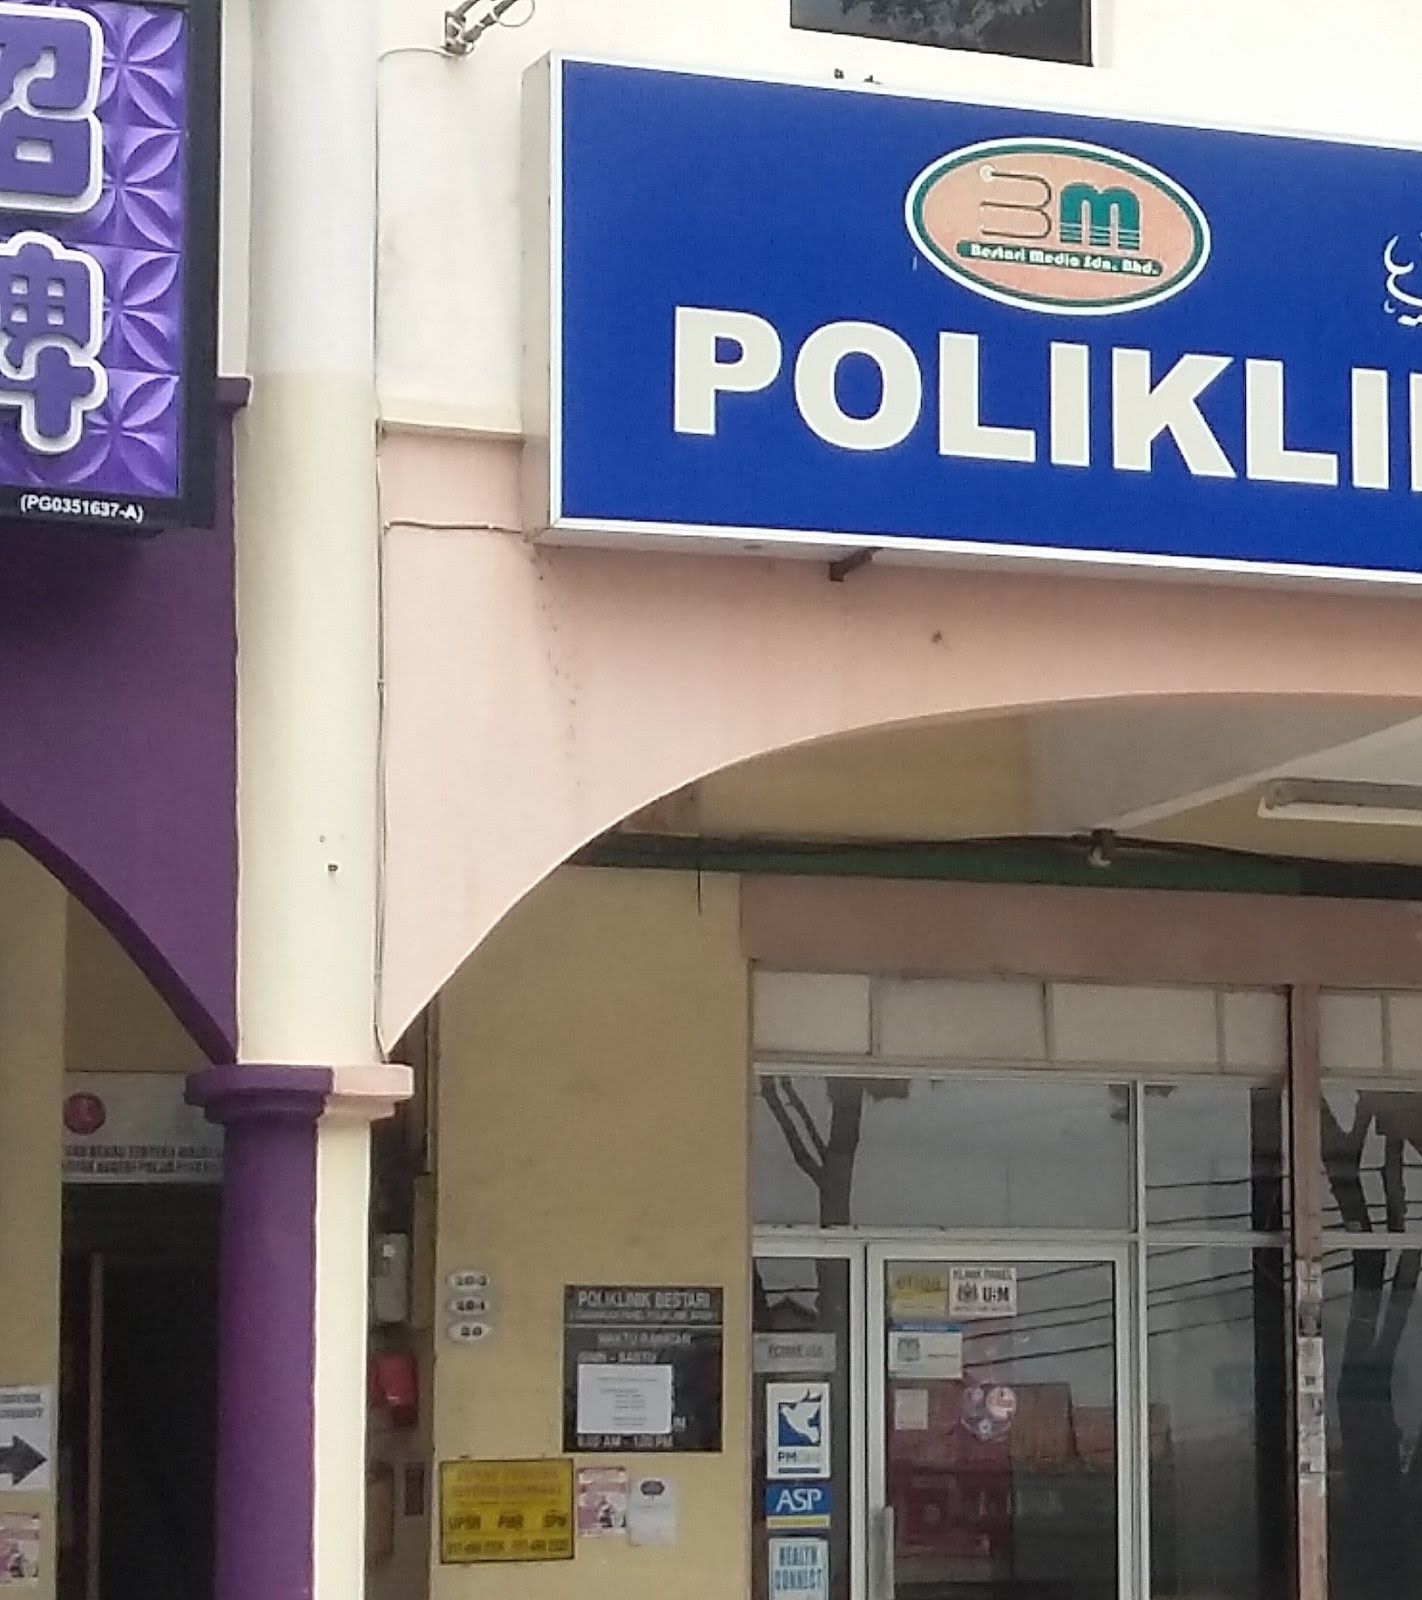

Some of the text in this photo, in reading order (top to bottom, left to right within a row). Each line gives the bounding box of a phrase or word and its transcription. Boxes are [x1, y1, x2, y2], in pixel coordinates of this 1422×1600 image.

[971, 243, 1160, 276] Bestari Media Sdn. Bhd.
[20, 494, 144, 524] (PG0351637-A)
[578, 1290, 711, 1308] POLIKLINIK BESTARI
[776, 1487, 823, 1513] ASP
